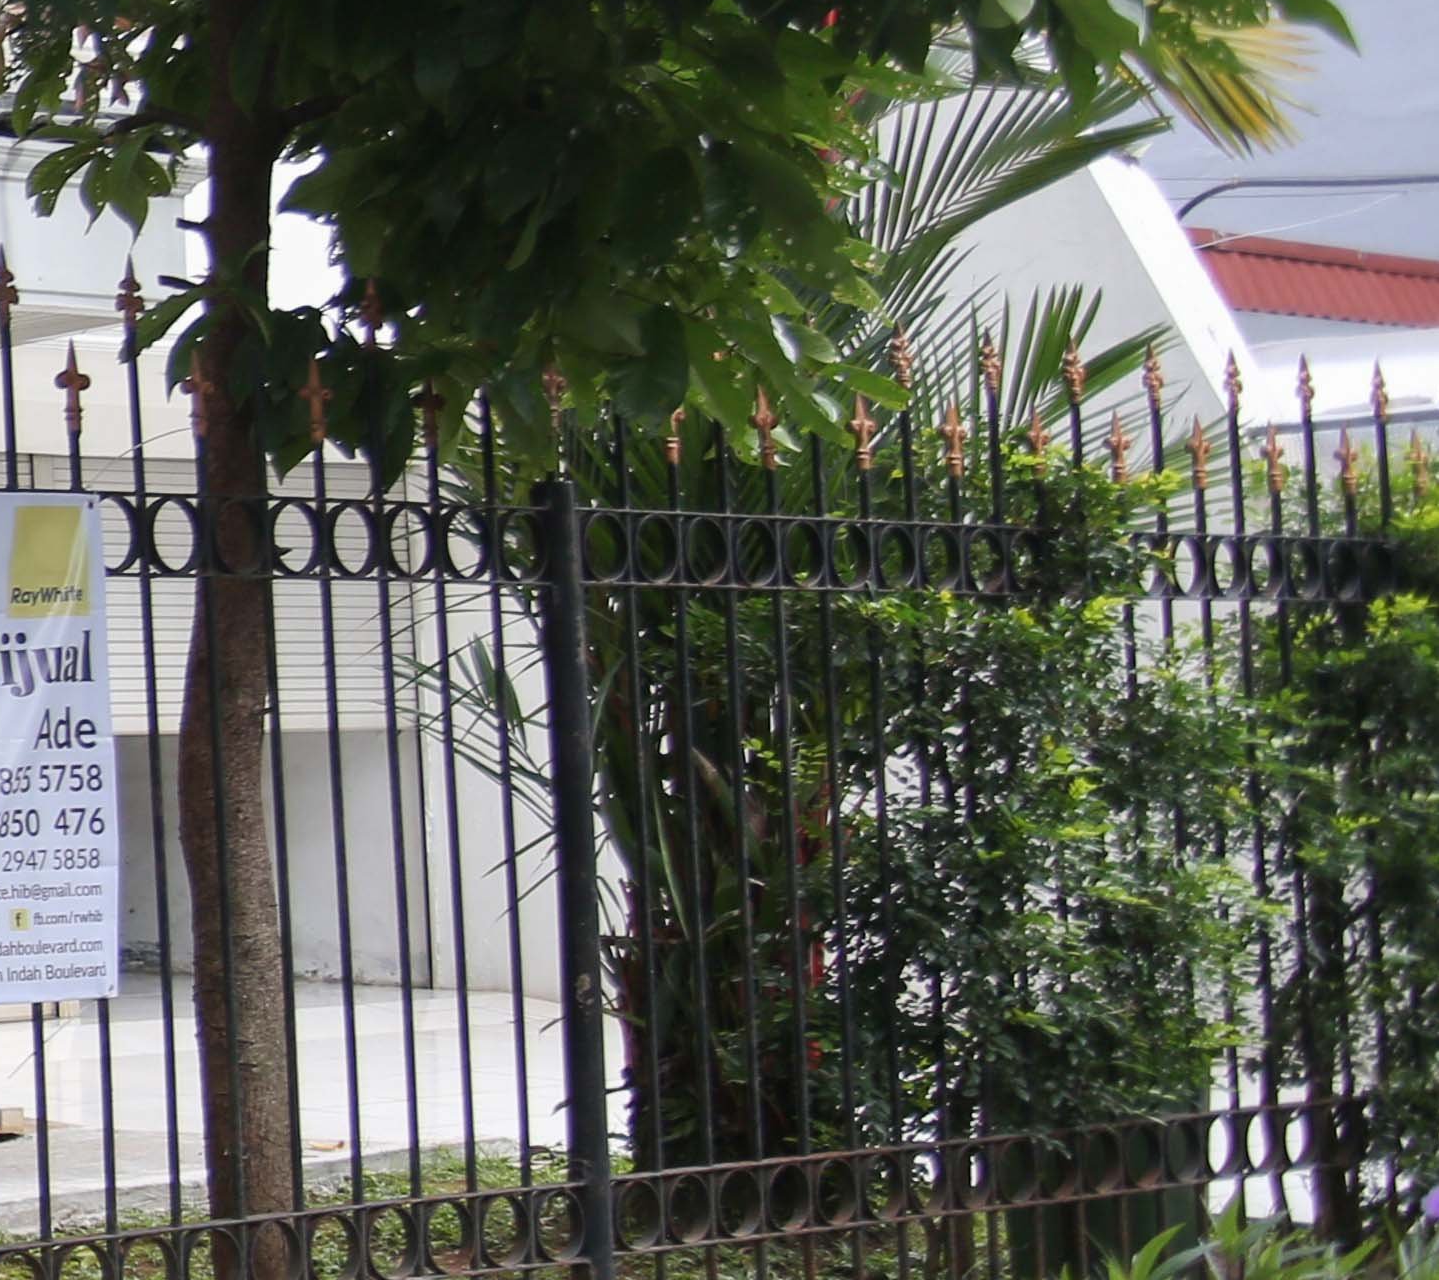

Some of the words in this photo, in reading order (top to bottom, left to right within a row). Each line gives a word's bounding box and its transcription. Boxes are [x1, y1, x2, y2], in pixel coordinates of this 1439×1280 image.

[34, 706, 97, 750] Ade
[38, 764, 103, 793] 5758
[54, 807, 105, 835] 476
[2, 850, 47, 872] 2947
[53, 848, 100, 869] 5858
[7, 967, 41, 982] Indah
